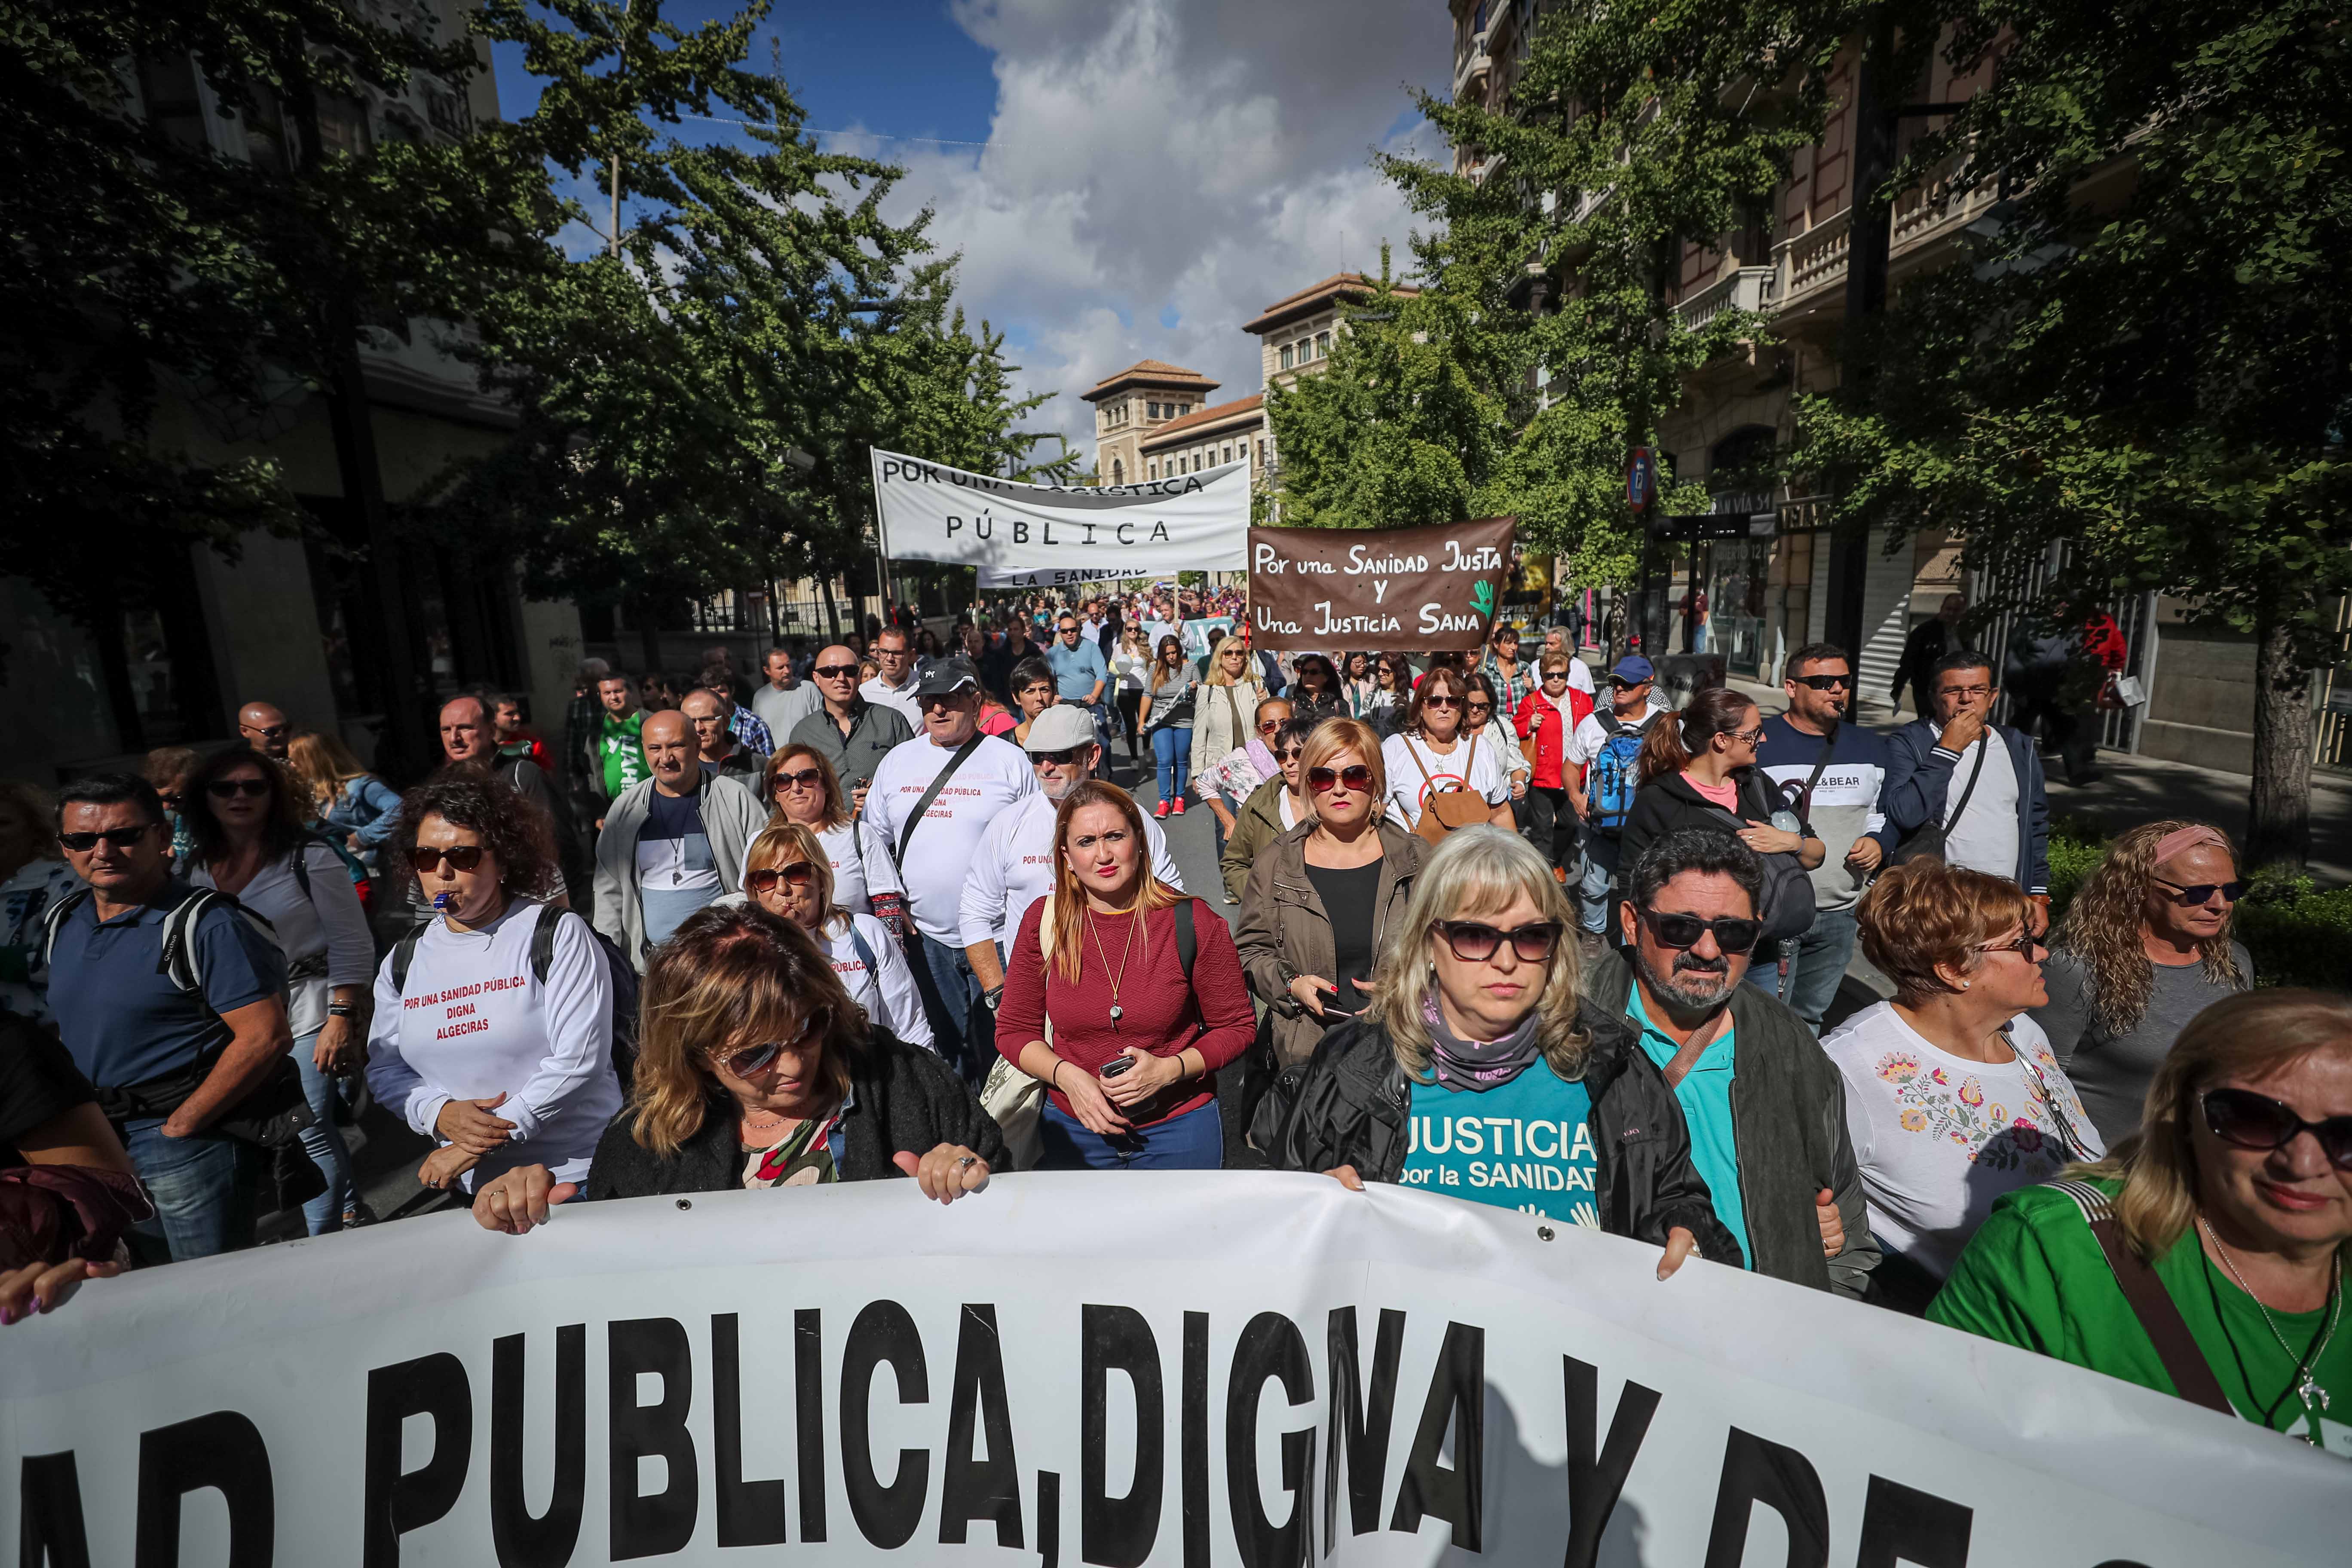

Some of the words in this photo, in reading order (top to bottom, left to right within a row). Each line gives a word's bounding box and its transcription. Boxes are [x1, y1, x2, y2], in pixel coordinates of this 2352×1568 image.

[946, 508, 1170, 544] PÚBLICA
[1255, 542, 1289, 574] Por
[1297, 560, 1337, 574] una
[1441, 540, 1502, 572] JUSTA
[1012, 574, 1038, 586] LA
[1257, 606, 1302, 634] Una
[1418, 603, 1479, 635] SANA
[954, 786, 981, 796] PÚBLICA
[922, 809, 952, 818] GECIRAS
[1023, 856, 1036, 864] POR
[1038, 855, 1053, 864] UNA
[164, 935, 177, 961] Quechua
[404, 997, 420, 1010] POR
[422, 992, 439, 1007] UNA
[441, 983, 481, 1003] SANIDAD
[484, 975, 526, 993] PÚBLICA
[447, 1002, 476, 1020] DIGNA
[436, 1018, 489, 1040] ALGECIRAS
[1407, 1116, 1598, 1162] JUSTICIA
[1439, 1164, 1460, 1186] la
[1081, 1303, 1485, 1568] DIGNA
[1562, 1353, 1663, 1568] Y
